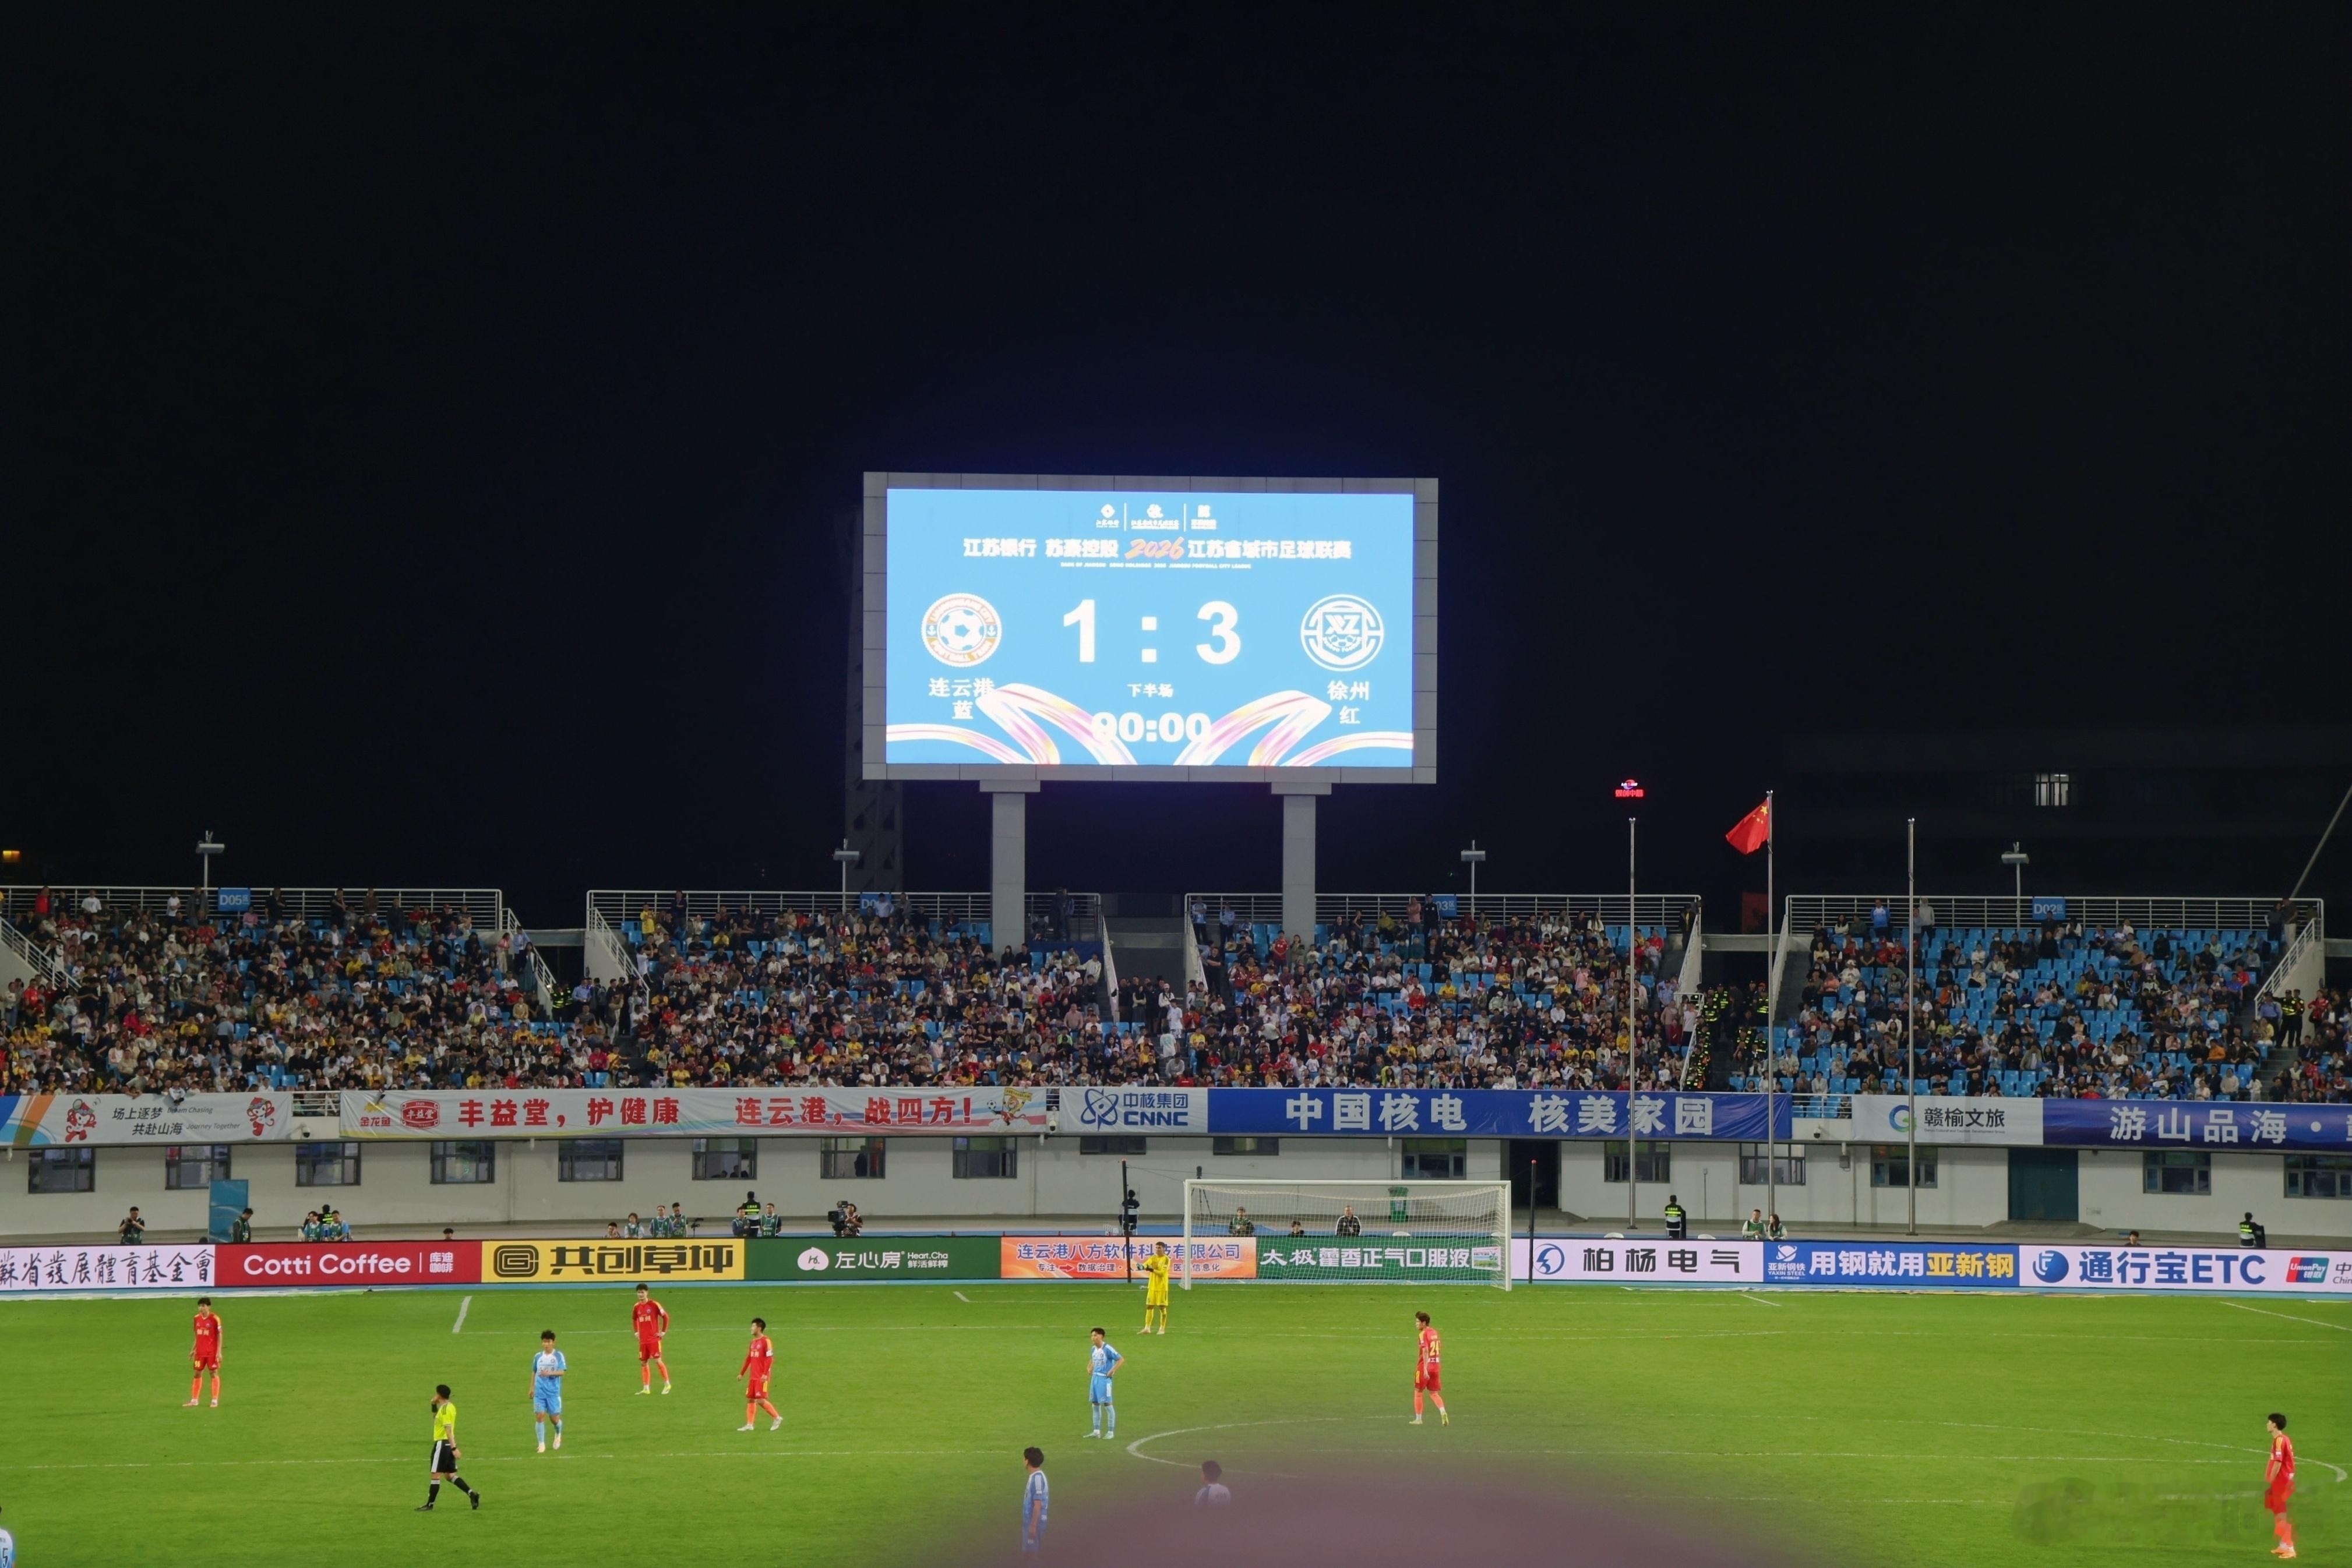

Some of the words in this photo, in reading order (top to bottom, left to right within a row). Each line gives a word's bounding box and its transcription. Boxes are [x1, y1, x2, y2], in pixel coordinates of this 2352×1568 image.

[1124, 536, 1184, 560] 2026
[1187, 539, 1352, 559] 江苏省城市足球联赛
[1063, 599, 1095, 662] 1
[1196, 601, 1241, 665] 3
[928, 677, 995, 698] 连云港
[1127, 683, 1174, 698] 下半场
[1327, 680, 1370, 701] 徐州
[951, 700, 974, 719] 蓝
[1339, 705, 1360, 725] 红
[1091, 711, 1212, 743] 90:00
[1123, 1093, 1189, 1109] 中核集团
[112, 1107, 163, 1120] 场上逐梦
[360, 1117, 391, 1127] 金龙鱼
[1123, 1111, 1189, 1126] CNNC
[1286, 1092, 1468, 1132] 中国核电
[1528, 1094, 1713, 1136] 核美家园
[1924, 1107, 2005, 1128] 赣榆文旅
[132, 1122, 184, 1136] 共赴山海
[244, 1253, 312, 1275] Cotti
[318, 1252, 411, 1274] Coffee
[429, 1252, 454, 1263] 库迪
[550, 1245, 734, 1275] 共创草坪
[835, 1251, 901, 1269] 左心房
[907, 1252, 948, 1260] Heart.Cha
[907, 1259, 948, 1269] 鲜活鲜榨
[1583, 1248, 1740, 1274] 柏杨电气
[1809, 1251, 2014, 1279] 用钢就用亚新钢
[429, 1263, 454, 1273] 咖啡
[1037, 1263, 1056, 1272] 专注
[1768, 1262, 1806, 1272] 亚新钢铁
[2079, 1251, 2266, 1285] 通行宝ETC
[2290, 1263, 2326, 1276] UnionPay
